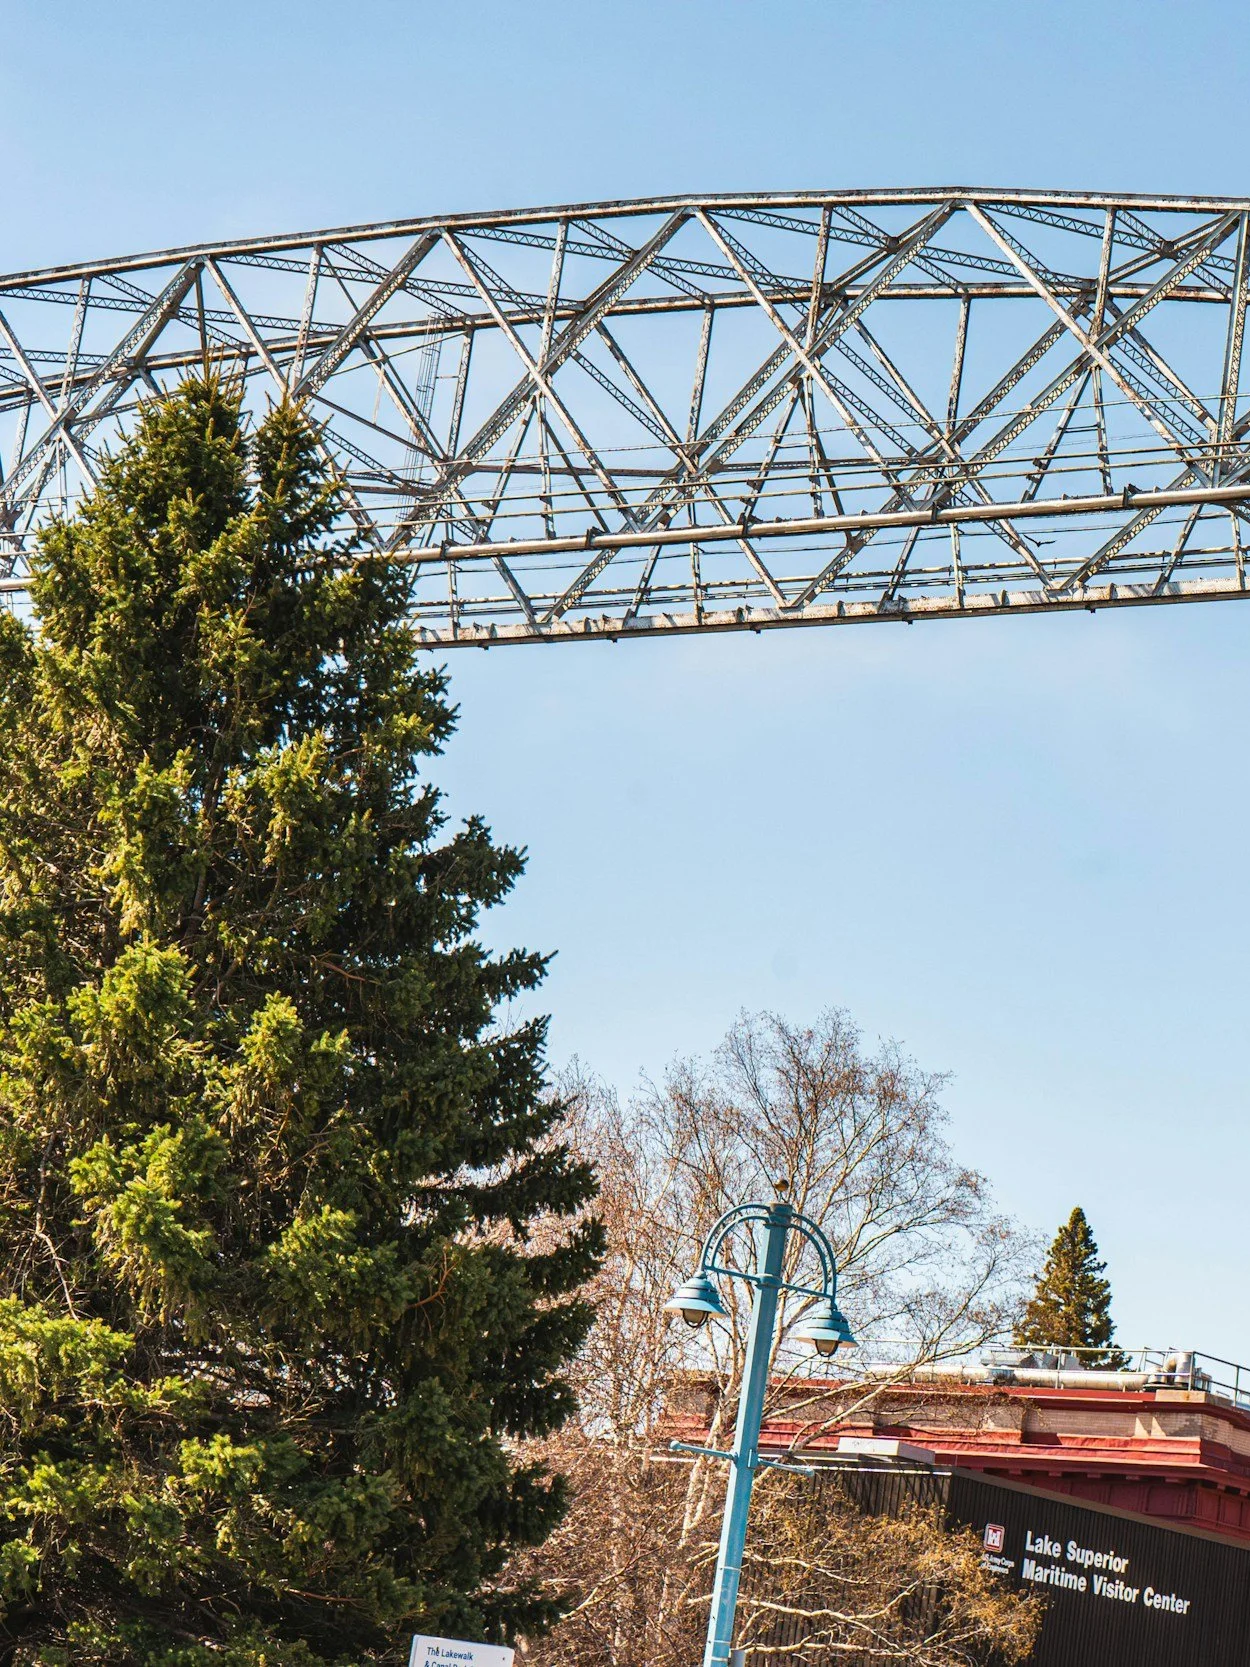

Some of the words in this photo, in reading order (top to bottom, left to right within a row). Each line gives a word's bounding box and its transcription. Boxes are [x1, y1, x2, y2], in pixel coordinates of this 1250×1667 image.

[1025, 1530, 1061, 1558] Lake
[1066, 1540, 1129, 1573] Superior
[1022, 1558, 1087, 1592] Maritime
[1093, 1574, 1140, 1604] Visitor
[1144, 1587, 1191, 1615] Center
[427, 1646, 440, 1656] The
[441, 1648, 474, 1660] Lakewalk
